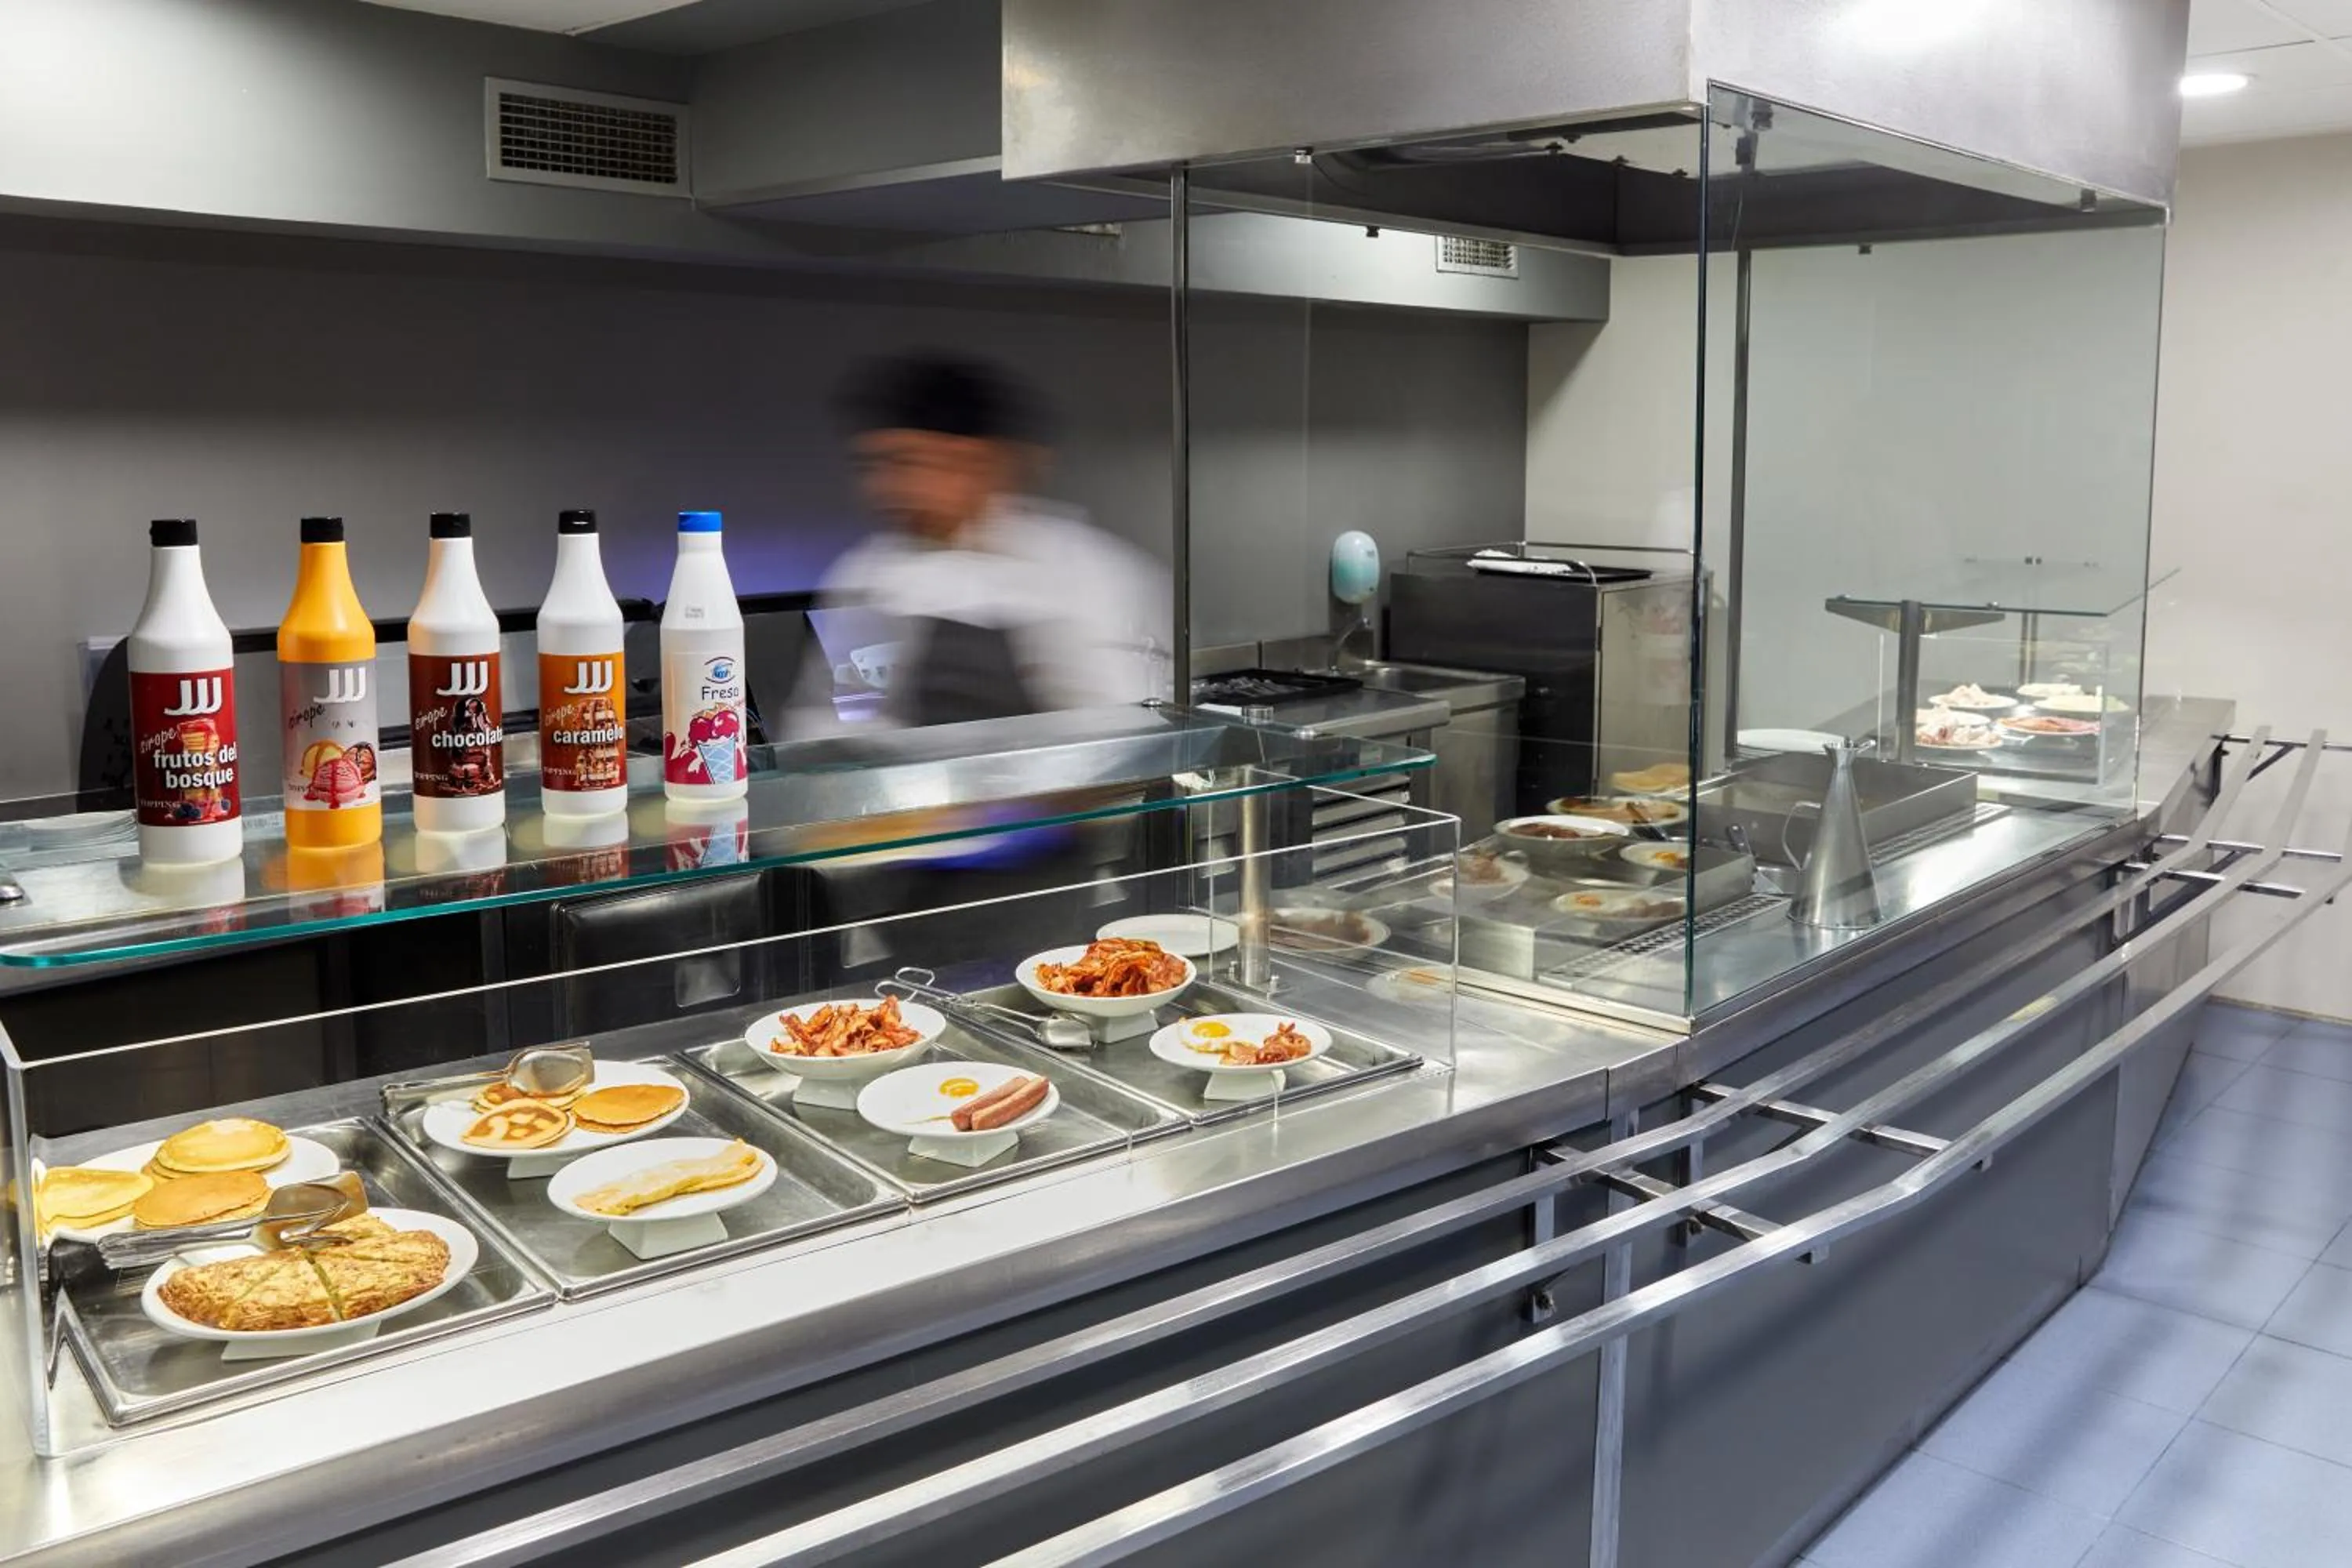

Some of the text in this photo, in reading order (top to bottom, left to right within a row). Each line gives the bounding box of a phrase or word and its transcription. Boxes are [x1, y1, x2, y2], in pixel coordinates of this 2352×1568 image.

[153, 741, 238, 769] frutos del
[165, 768, 234, 789] bosque
